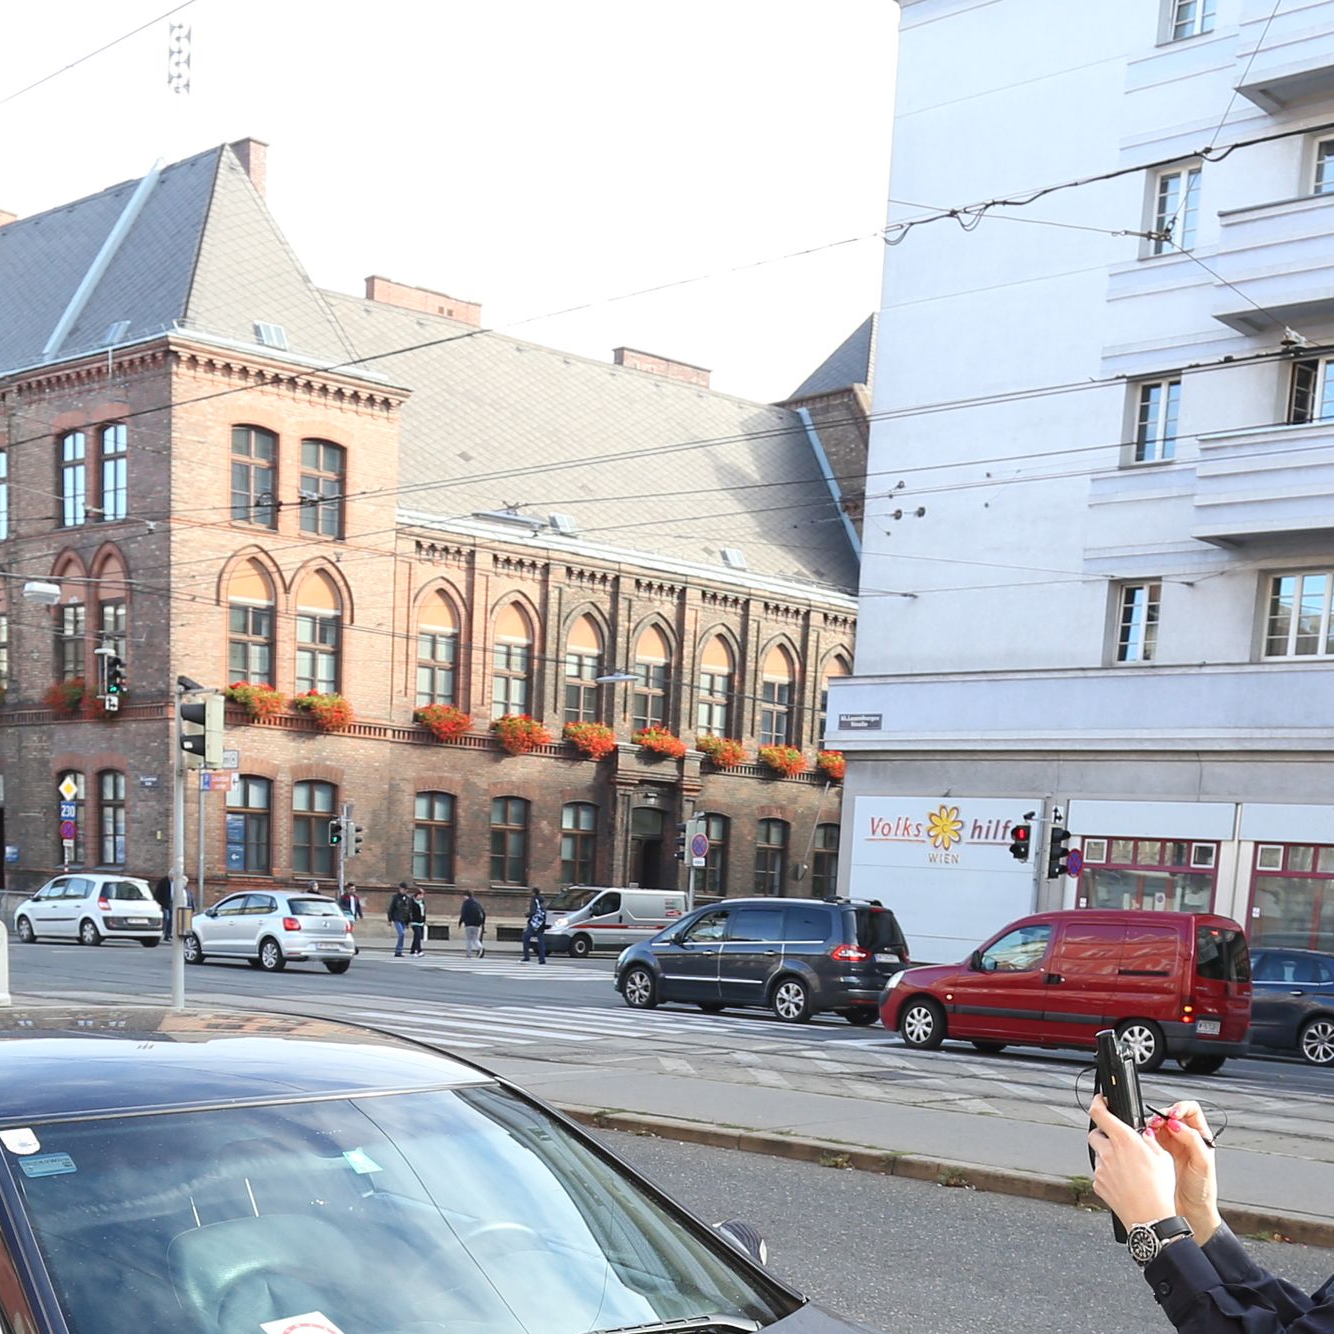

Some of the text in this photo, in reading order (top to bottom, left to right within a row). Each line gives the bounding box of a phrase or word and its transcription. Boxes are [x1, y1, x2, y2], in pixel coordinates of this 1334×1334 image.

[61, 804, 76, 818] 230
[870, 817, 1013, 841] Volks hilf
[927, 853, 960, 865] WIEN
